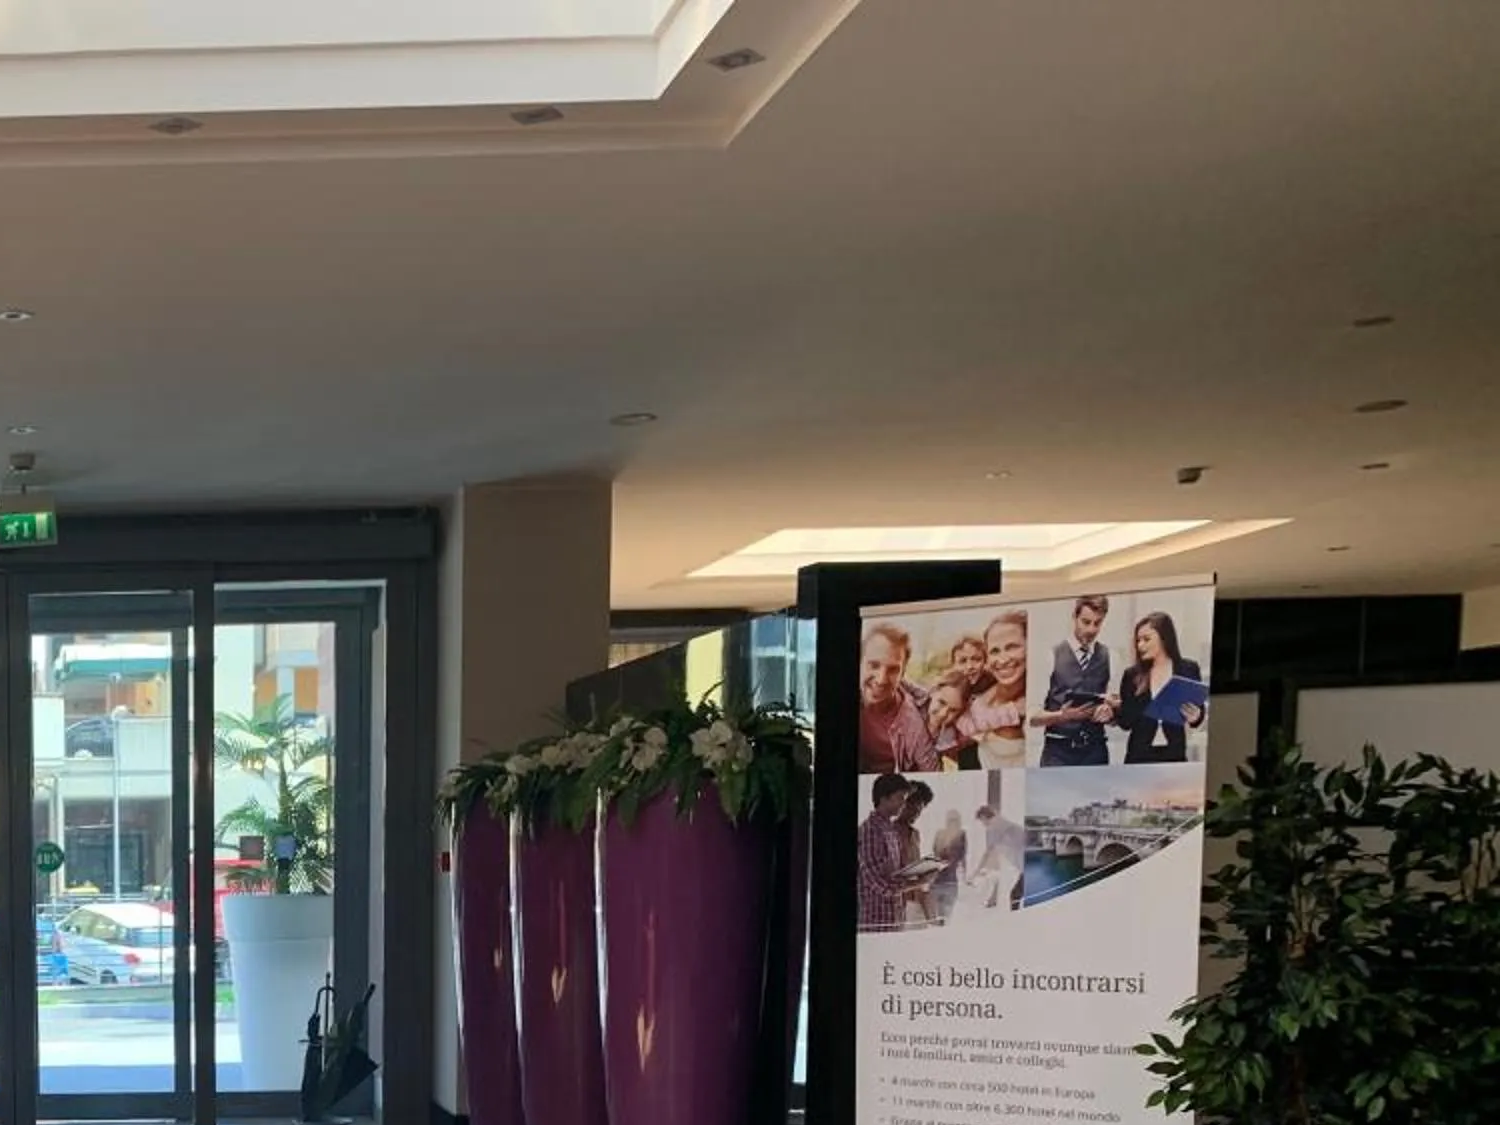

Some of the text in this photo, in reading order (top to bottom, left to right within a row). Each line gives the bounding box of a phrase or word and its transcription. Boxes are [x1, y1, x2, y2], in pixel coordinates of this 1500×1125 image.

[883, 961, 896, 985] È
[949, 966, 1005, 989] bello
[1012, 968, 1145, 993] incontrarsi
[881, 993, 1003, 1020] di persona.
[1043, 1042, 1100, 1056] ovunque
[1055, 1087, 1095, 1100] Europa
[1078, 1110, 1121, 1122] mondo
